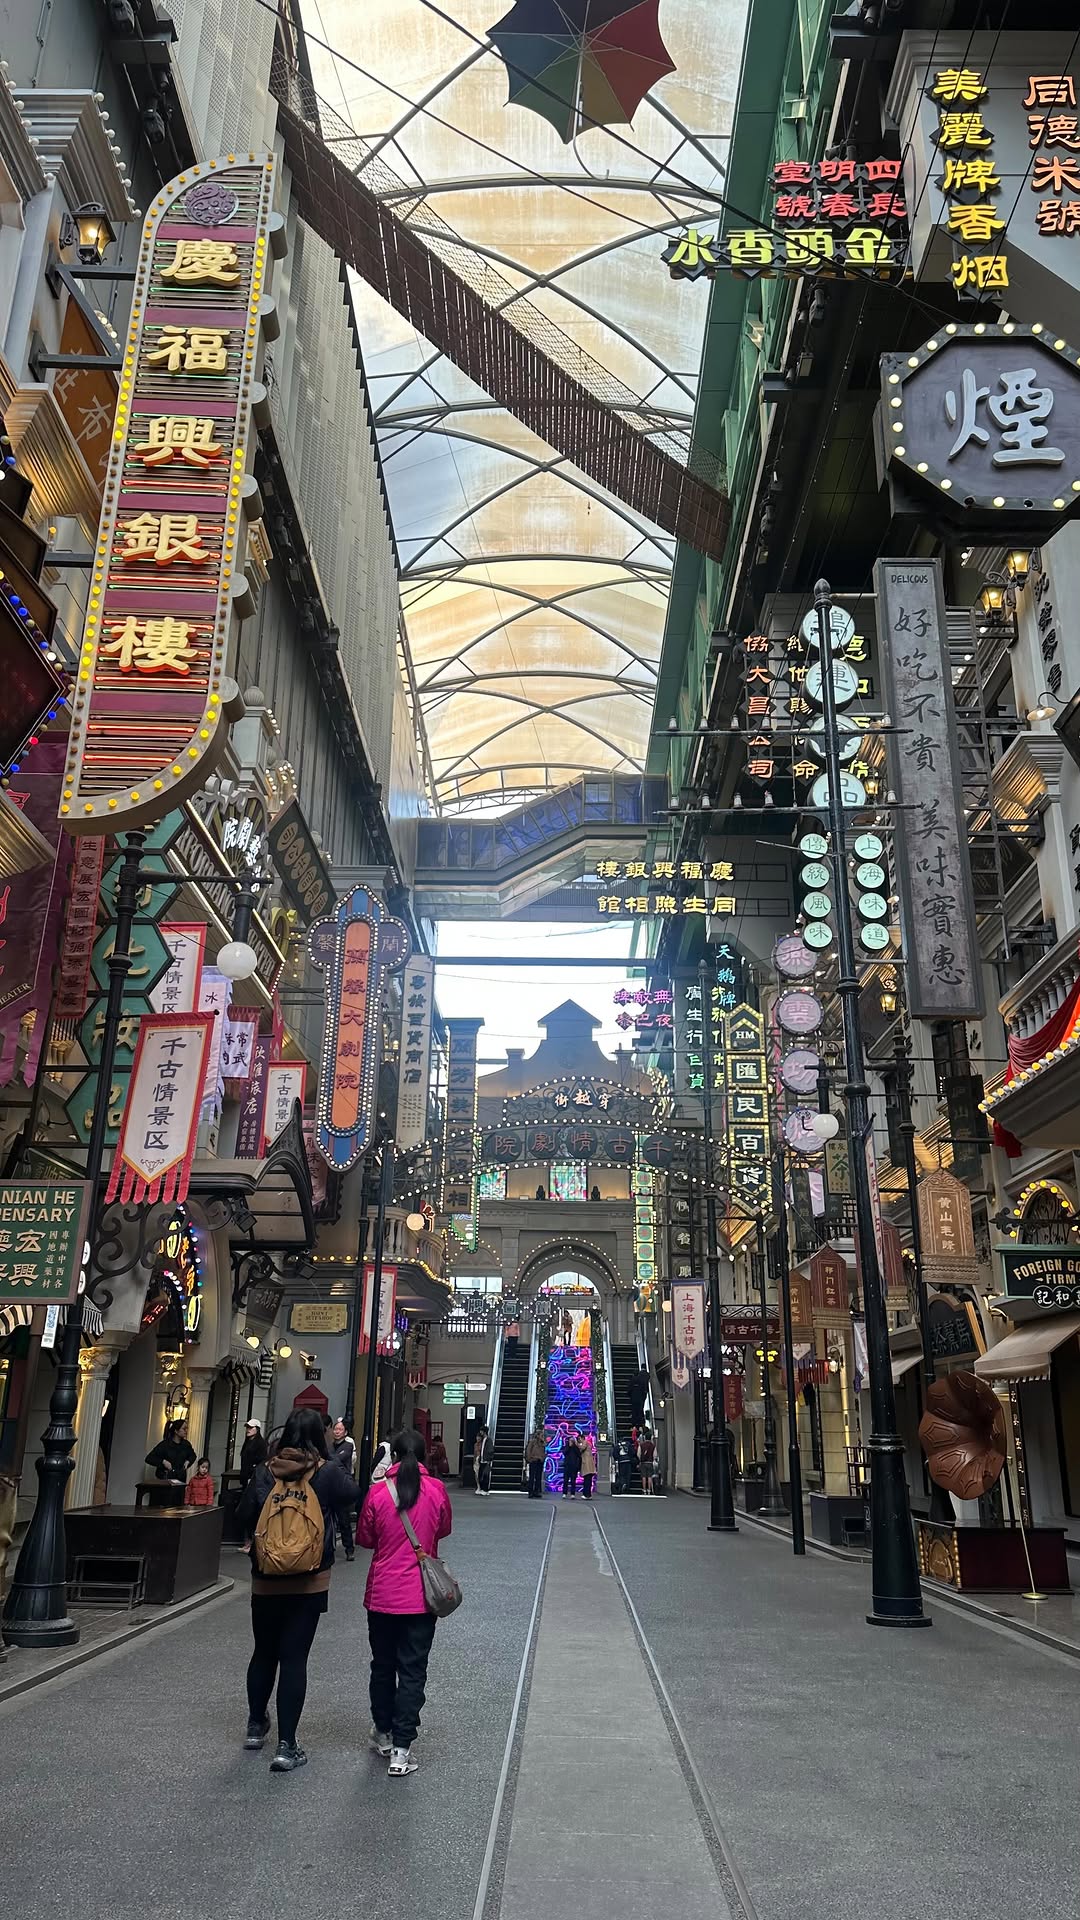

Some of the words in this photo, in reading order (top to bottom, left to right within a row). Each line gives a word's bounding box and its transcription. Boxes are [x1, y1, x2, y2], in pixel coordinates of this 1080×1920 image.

[945, 368, 1066, 467] 煙
[105, 239, 243, 675] 慶福興銀樓
[891, 574, 929, 585] DELICOUS
[736, 1031, 755, 1040] HM
[143, 1037, 187, 1150] 千古情景区
[275, 1073, 293, 1132] 千古情景区
[735, 1062, 764, 1186] 匯民百貨
[54, 1191, 75, 1205] HE
[1013, 1259, 1062, 1280] FOREIGN
[1046, 1274, 1076, 1284] FIRM
[682, 1293, 696, 1346] 上海千古情
